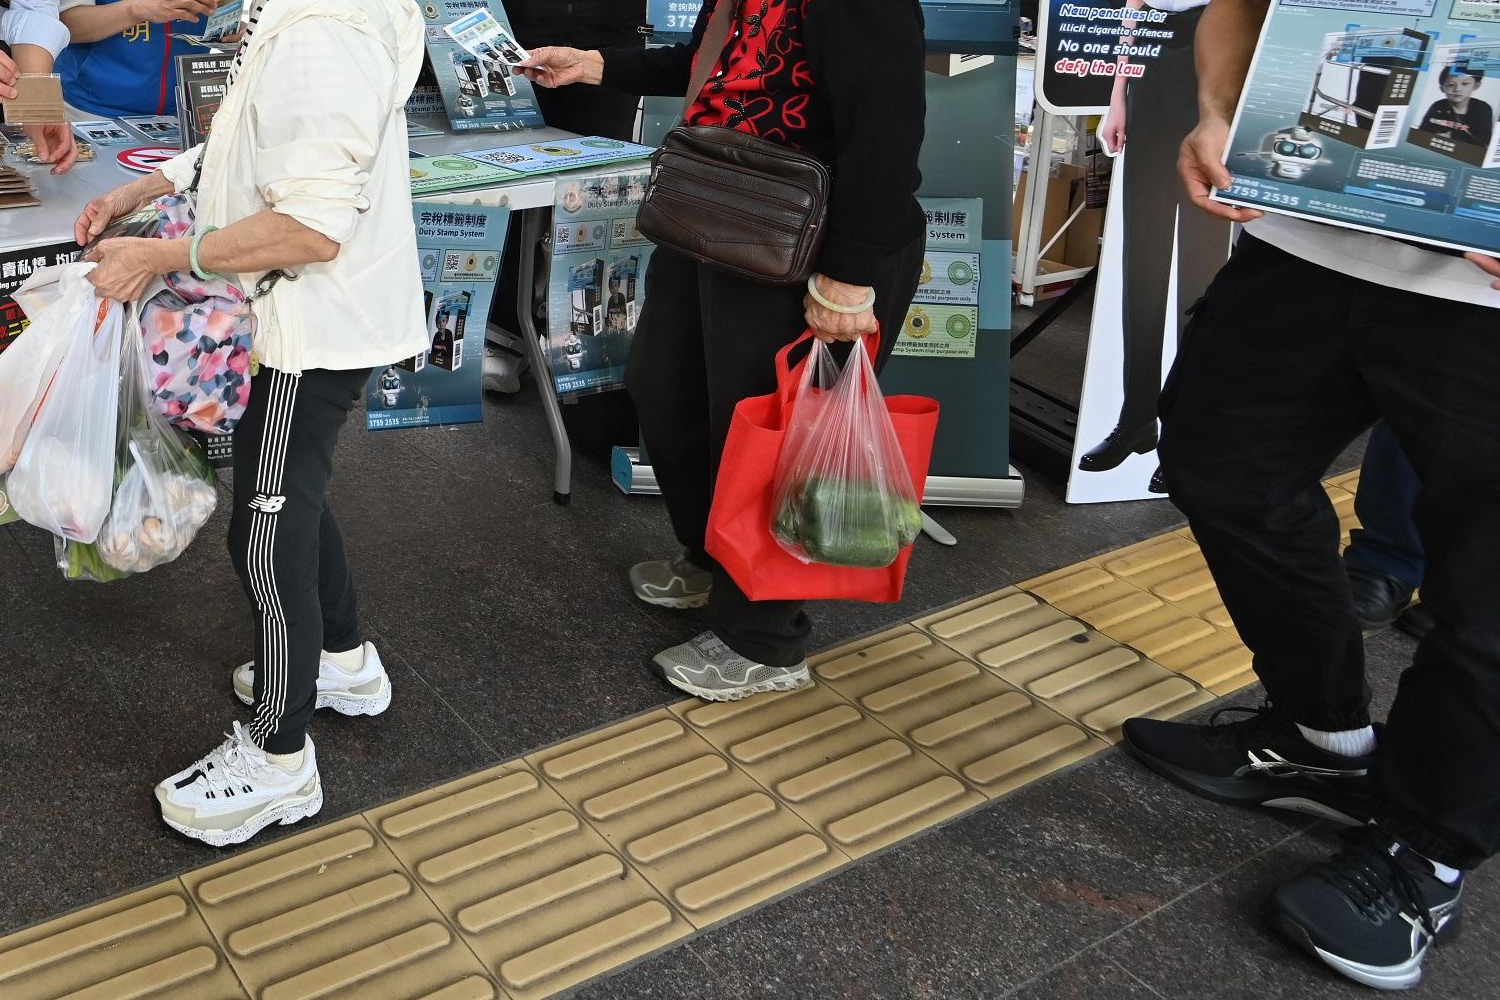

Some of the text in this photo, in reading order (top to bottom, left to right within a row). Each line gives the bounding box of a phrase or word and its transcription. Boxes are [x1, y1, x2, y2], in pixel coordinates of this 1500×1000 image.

[1059, 4, 1168, 23] New penalties for
[1060, 24, 1174, 39] illicit cigarette offences
[1058, 40, 1161, 57] No one should
[1054, 57, 1146, 77] defy the law
[1262, 190, 1299, 206] 2535
[419, 228, 484, 238] Duty Stamp System
[930, 231, 965, 241] System
